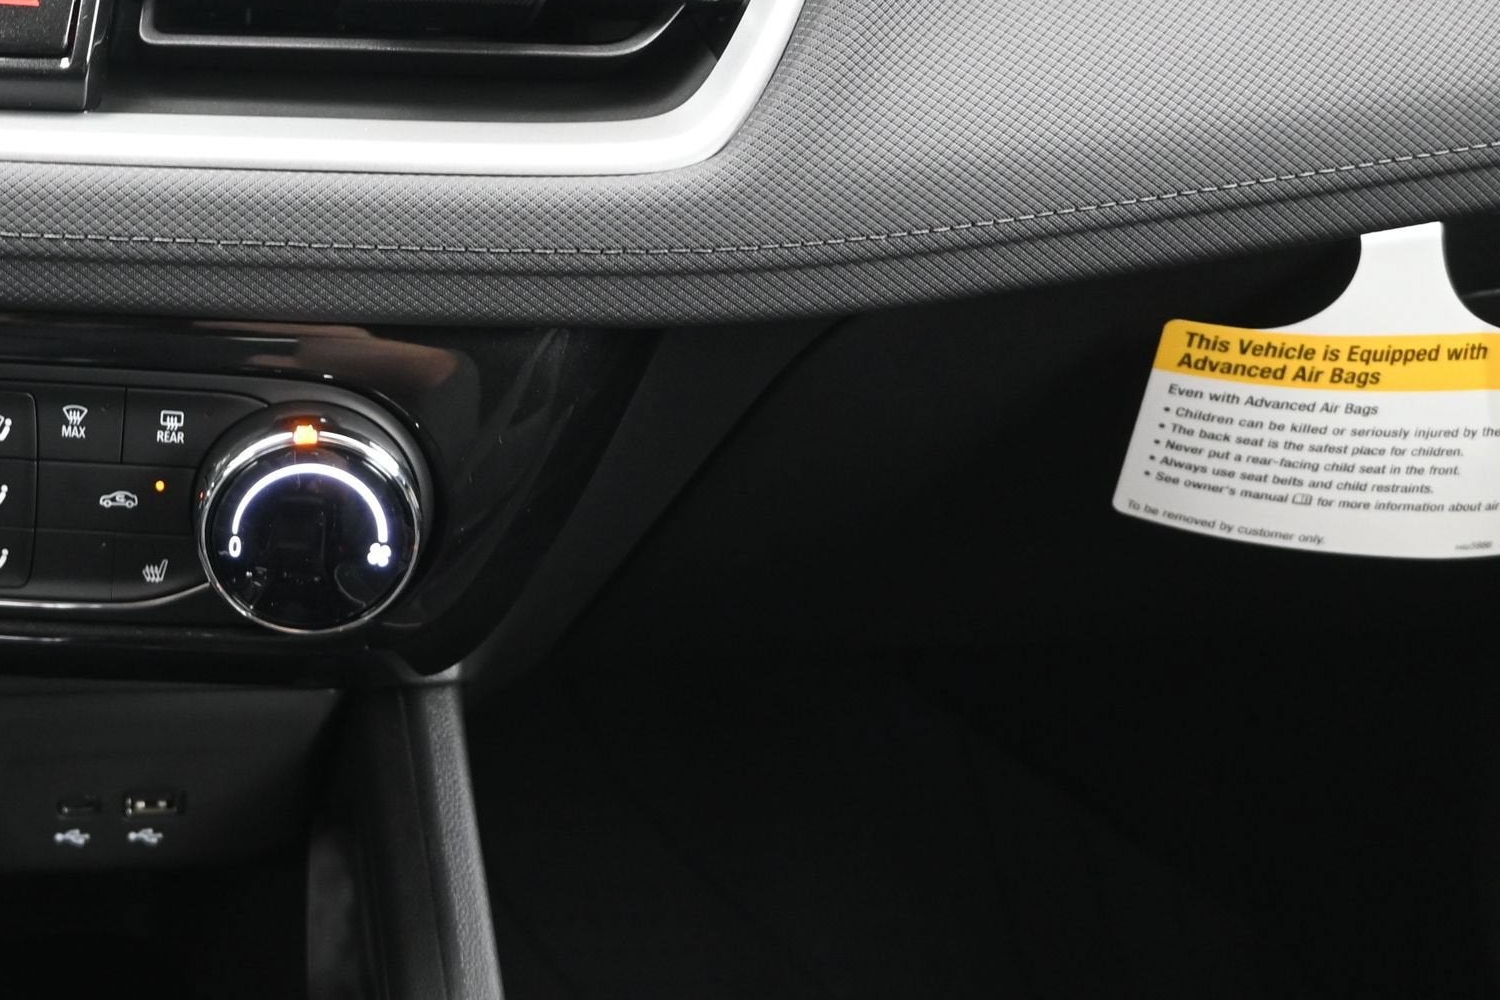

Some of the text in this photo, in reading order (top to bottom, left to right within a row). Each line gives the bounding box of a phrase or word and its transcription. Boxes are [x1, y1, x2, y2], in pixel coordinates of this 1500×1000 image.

[1185, 331, 1488, 366] This Vehicle is Equipped with
[1177, 353, 1381, 388] Advanced Air Bags
[1168, 383, 1378, 417] Even with Advanced Air Bags
[61, 425, 86, 439] MAX
[156, 430, 185, 444] REAR
[1171, 423, 1464, 457] The back seat is the safest place for children.
[1175, 406, 1234, 425] Children
[1238, 418, 1264, 429] can
[1268, 420, 1286, 432] be
[1290, 422, 1328, 435] killed
[1332, 426, 1347, 436] or
[1350, 427, 1409, 440] seriously
[1414, 427, 1460, 440] injured
[1463, 427, 1477, 439] by
[1159, 455, 1434, 495] Always use seat belts and child restraints.
[1165, 439, 1461, 476] Never put a rear-facing child seat in the front.
[1155, 471, 1180, 485] See
[1183, 479, 1236, 496] owner's
[1240, 488, 1289, 504] manual
[1317, 496, 1334, 507] for
[1338, 500, 1371, 510] more
[1374, 501, 1444, 513] information
[1448, 501, 1482, 512] about
[1127, 500, 1141, 511] To
[1143, 504, 1159, 516] be
[1162, 509, 1216, 529] removed
[1219, 521, 1234, 533] by
[1237, 525, 1294, 541] customer
